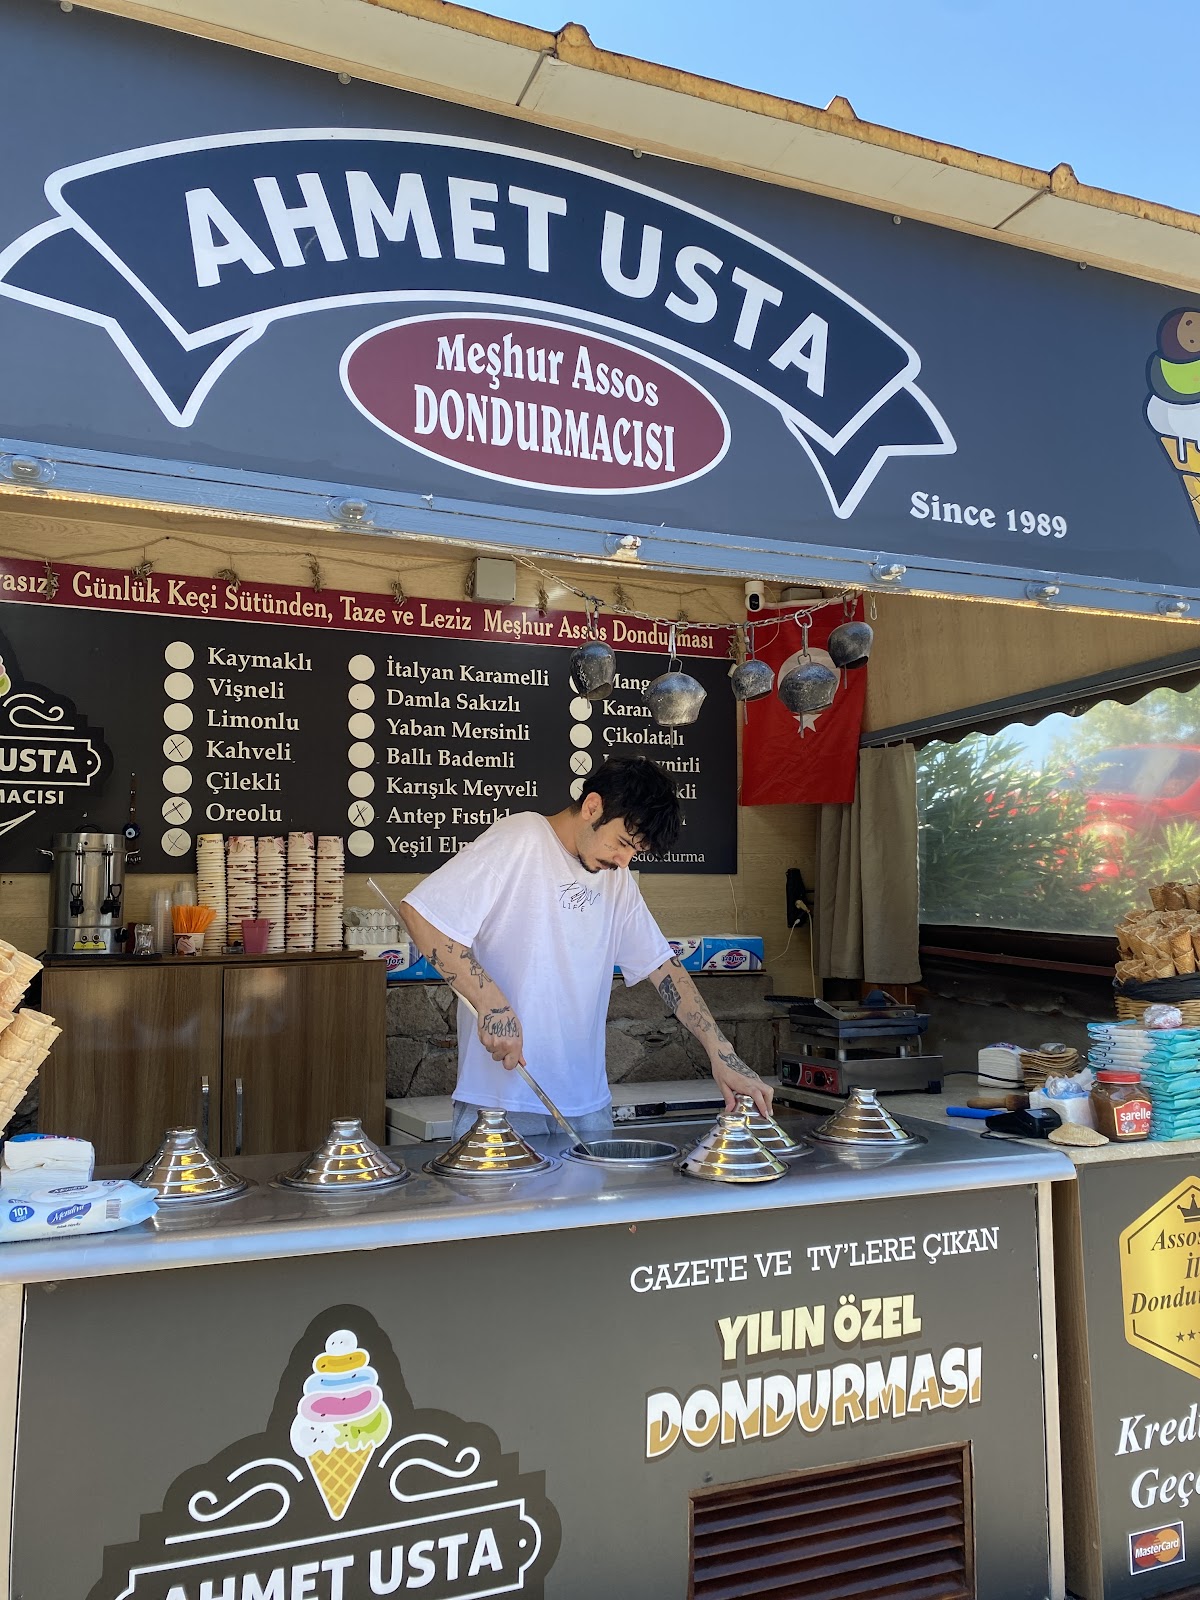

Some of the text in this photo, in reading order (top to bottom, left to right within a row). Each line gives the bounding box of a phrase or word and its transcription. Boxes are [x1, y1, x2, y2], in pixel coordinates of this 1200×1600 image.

[186, 170, 829, 398] AHMET USTA
[436, 332, 659, 407] Meşhur Assos
[414, 384, 676, 472] DONDURMACISI
[910, 491, 1067, 539] Since 1989
[72, 570, 160, 604] Günlük
[168, 579, 218, 613] Keçi
[224, 584, 333, 623] Sütünden,
[340, 595, 386, 624] Taze
[392, 609, 414, 626] ve
[420, 602, 472, 631] Leziz
[484, 608, 554, 640] Meşhur
[558, 615, 607, 642] Assos
[613, 619, 714, 650] Donduması
[207, 646, 313, 673] Kaymaklı
[386, 654, 550, 688] İtalyan Karamelli
[207, 677, 285, 702] Vişneli
[386, 688, 521, 713] Damla Sakızlı
[207, 708, 300, 732] Limonlu
[386, 717, 531, 742] Yaban Mersinli
[602, 725, 685, 747] Çikolatalı
[0, 747, 78, 775] USTA
[206, 740, 291, 762] Kahveli
[386, 747, 516, 769] Ballı Bademli
[205, 771, 282, 796] Çilekli
[386, 776, 539, 802] Karışık Meyveli
[205, 802, 283, 823] Oreolu
[385, 806, 446, 830] Antep
[385, 836, 432, 858] Yeşil
[1120, 1108, 1151, 1121] sarelle
[12, 1206, 29, 1218] 101
[1151, 1228, 1200, 1252] Asso
[629, 1255, 748, 1293] GAZETE
[754, 1250, 791, 1277] VE
[923, 1226, 999, 1265] ÇIKAN
[1130, 1285, 1200, 1316] Dondu
[717, 1293, 922, 1361] YILIN ÖZEL
[645, 1346, 983, 1459] DONDURMASI
[1134, 1537, 1180, 1559] MasterCard
[369, 1527, 503, 1596] USTA
